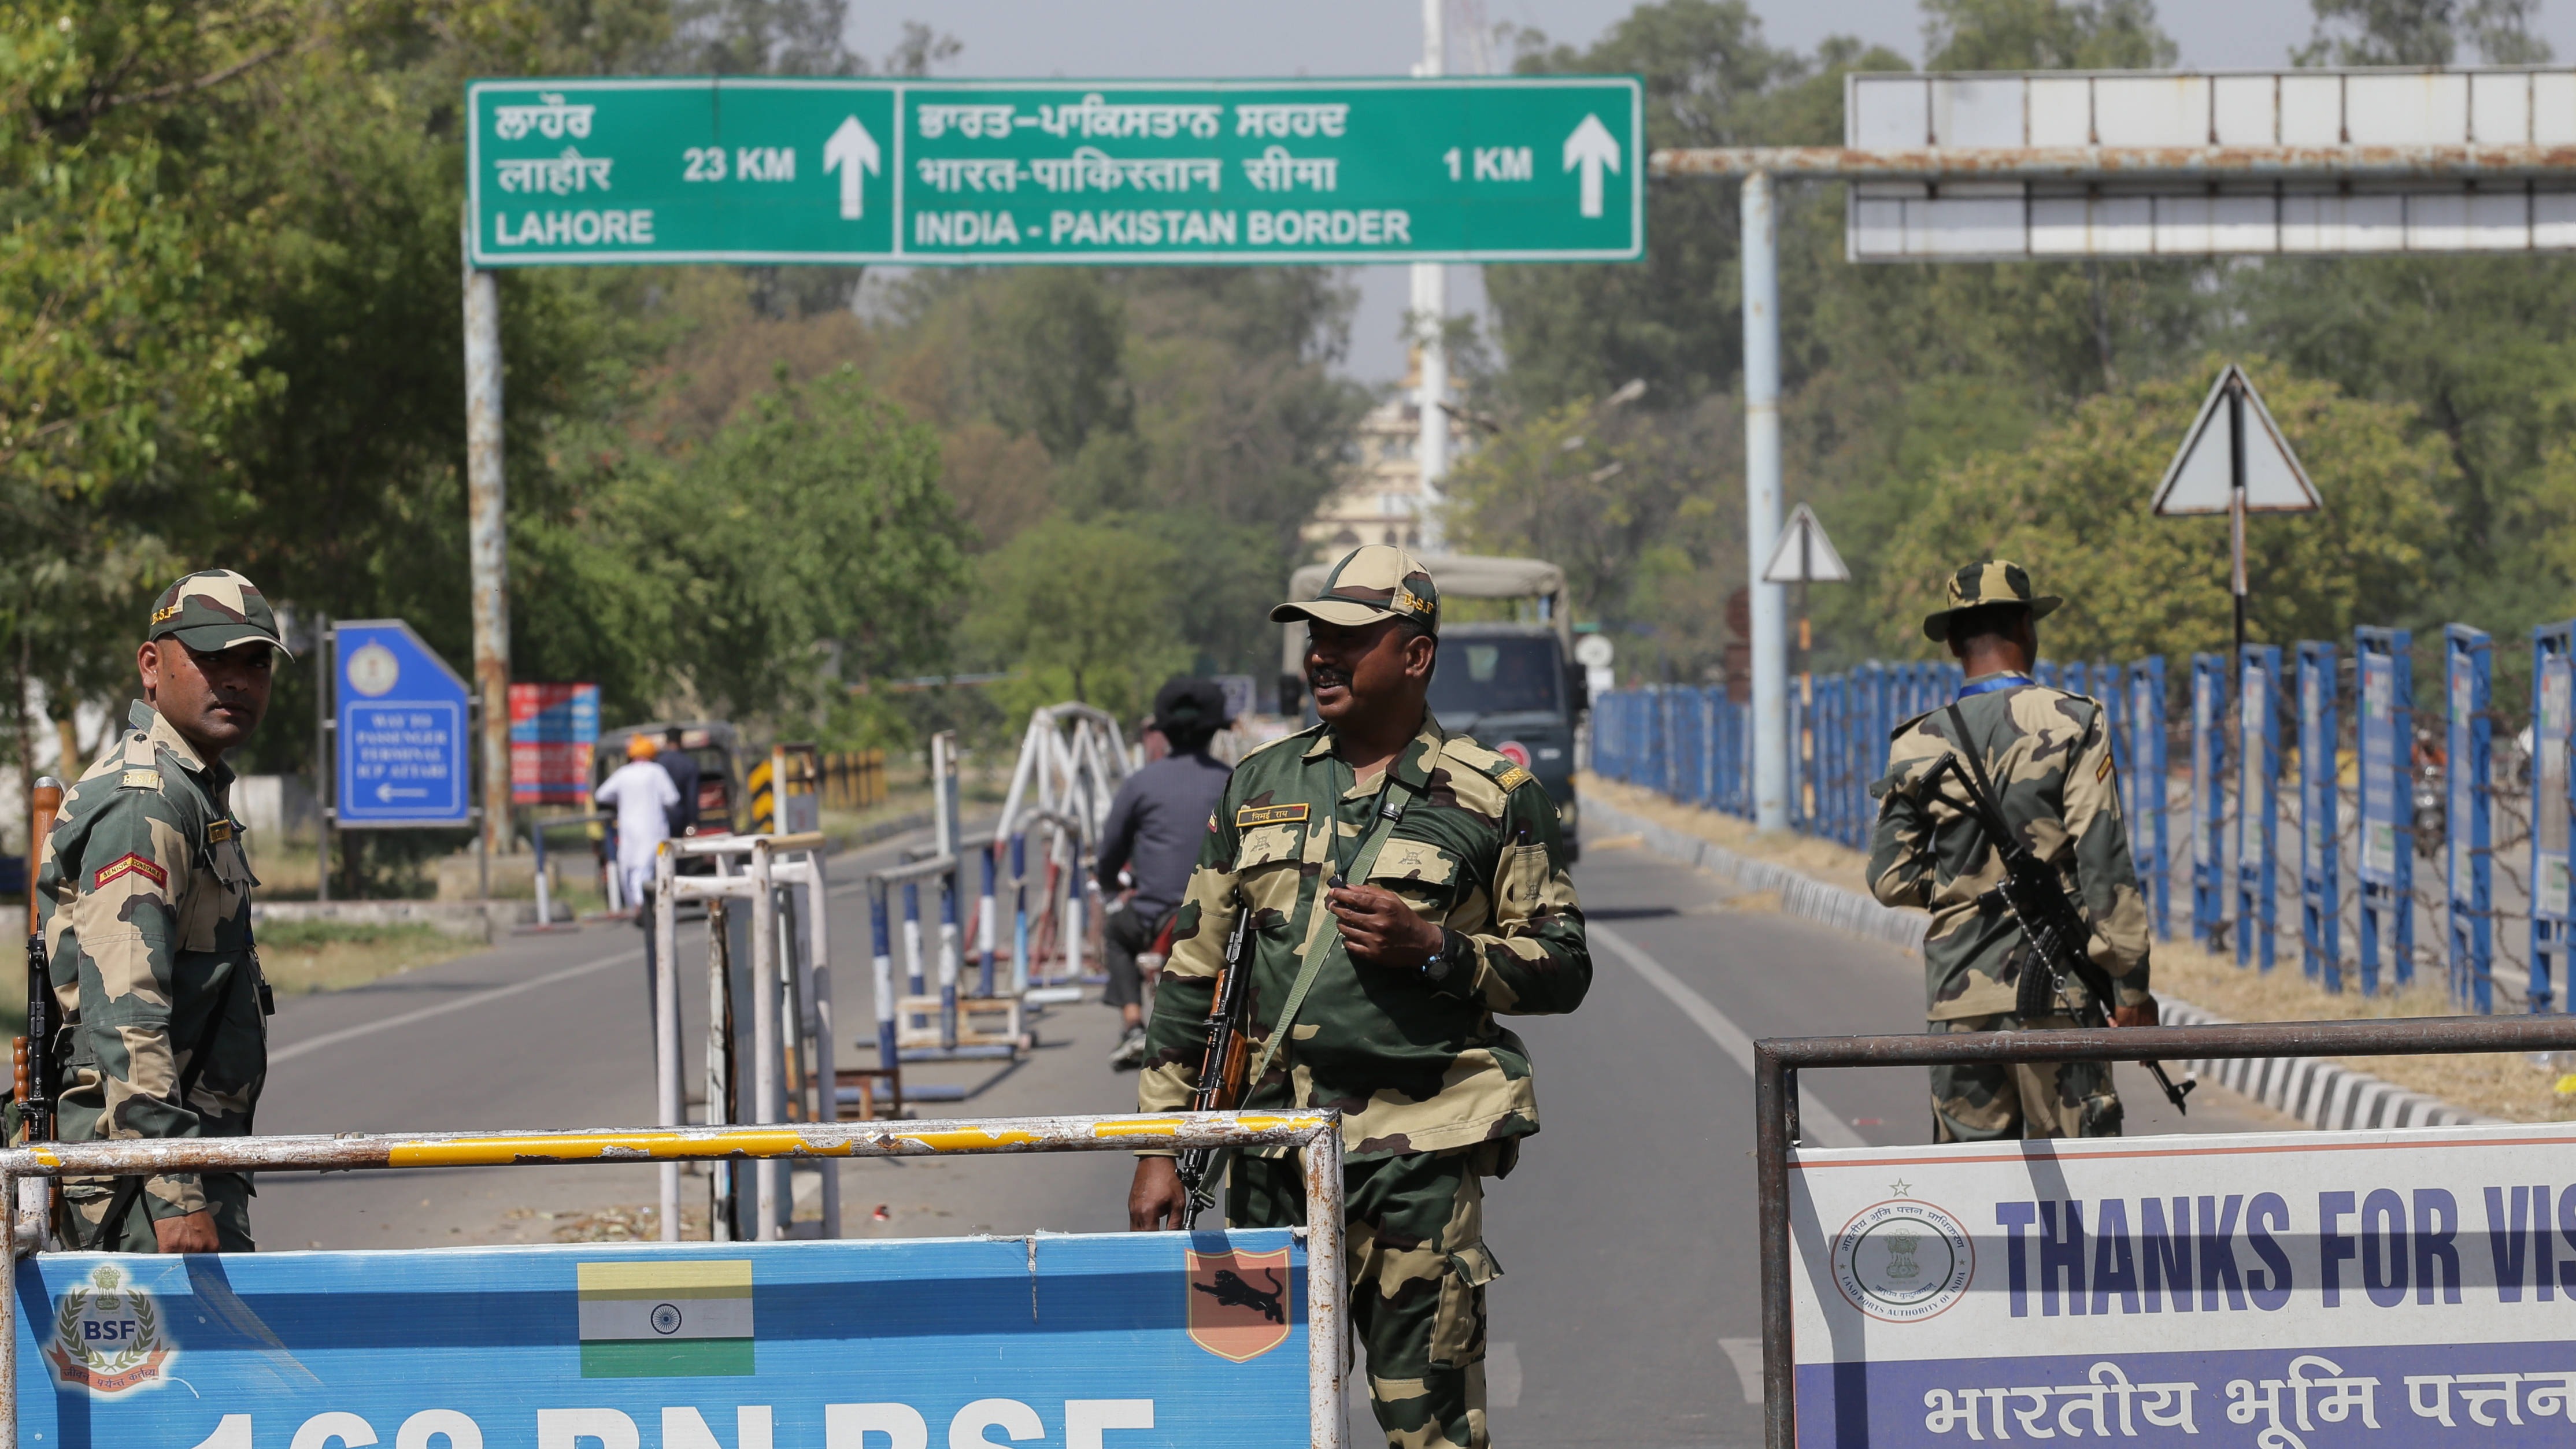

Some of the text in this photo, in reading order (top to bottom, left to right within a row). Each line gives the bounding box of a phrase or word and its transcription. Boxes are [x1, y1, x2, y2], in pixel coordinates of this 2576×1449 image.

[495, 146, 613, 195] लाहौर
[683, 147, 796, 181] 23 KM
[1241, 144, 1339, 192] सीमा
[1443, 146, 1533, 181] 1 KM
[495, 209, 655, 245] LAHORE
[915, 210, 1020, 245] INDIA
[1050, 210, 1237, 245] PAKISTAN
[1247, 209, 1411, 245] BORDER
[1274, 810, 1289, 818] राय
[103, 860, 161, 878] SENIOR CONSTABLE
[1842, 1218, 1867, 1251] भारतीय
[1870, 1207, 1892, 1221] भूमि
[1927, 1211, 1965, 1248] प्राधिकरण
[1996, 1192, 2293, 1318] THANKS
[2318, 1188, 2463, 1309] FOR
[1842, 1272, 1966, 1317] LAND PORTS AUTHORITY OF INDIA
[83, 1320, 136, 1340] BSF
[62, 1366, 90, 1381] जीवन
[1923, 1362, 2200, 1440] भारतीय
[2225, 1355, 2382, 1449] भूमि
